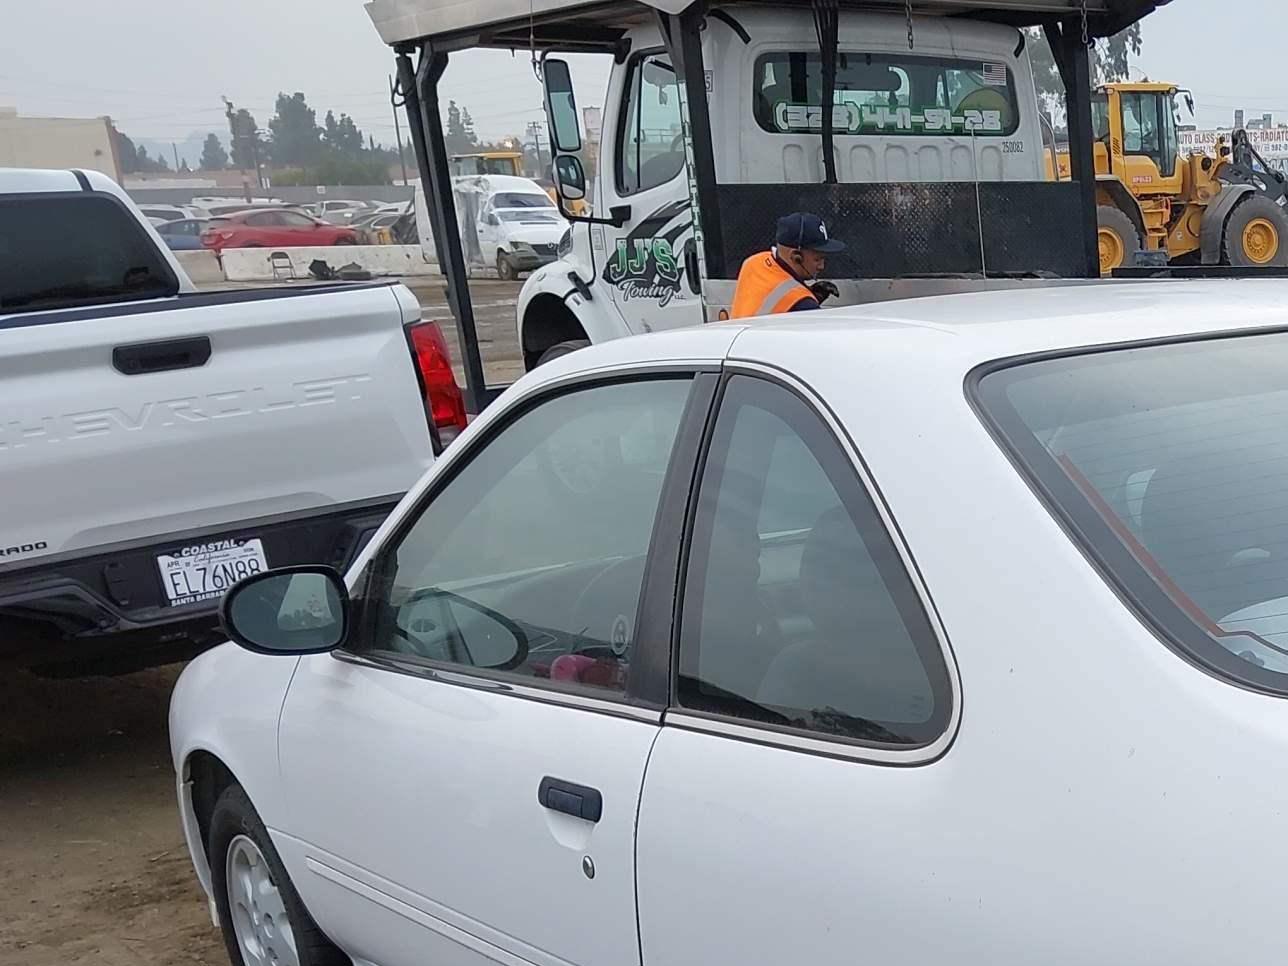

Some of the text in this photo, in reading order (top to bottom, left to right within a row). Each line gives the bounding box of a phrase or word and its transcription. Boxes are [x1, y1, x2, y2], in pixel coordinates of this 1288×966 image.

[608, 237, 680, 282] JJ'S
[617, 277, 674, 308] Towing
[0, 372, 372, 451] HEVROLET
[181, 539, 238, 557] COASTAL
[169, 558, 261, 597] EL76N88
[171, 595, 196, 607] SANTA
